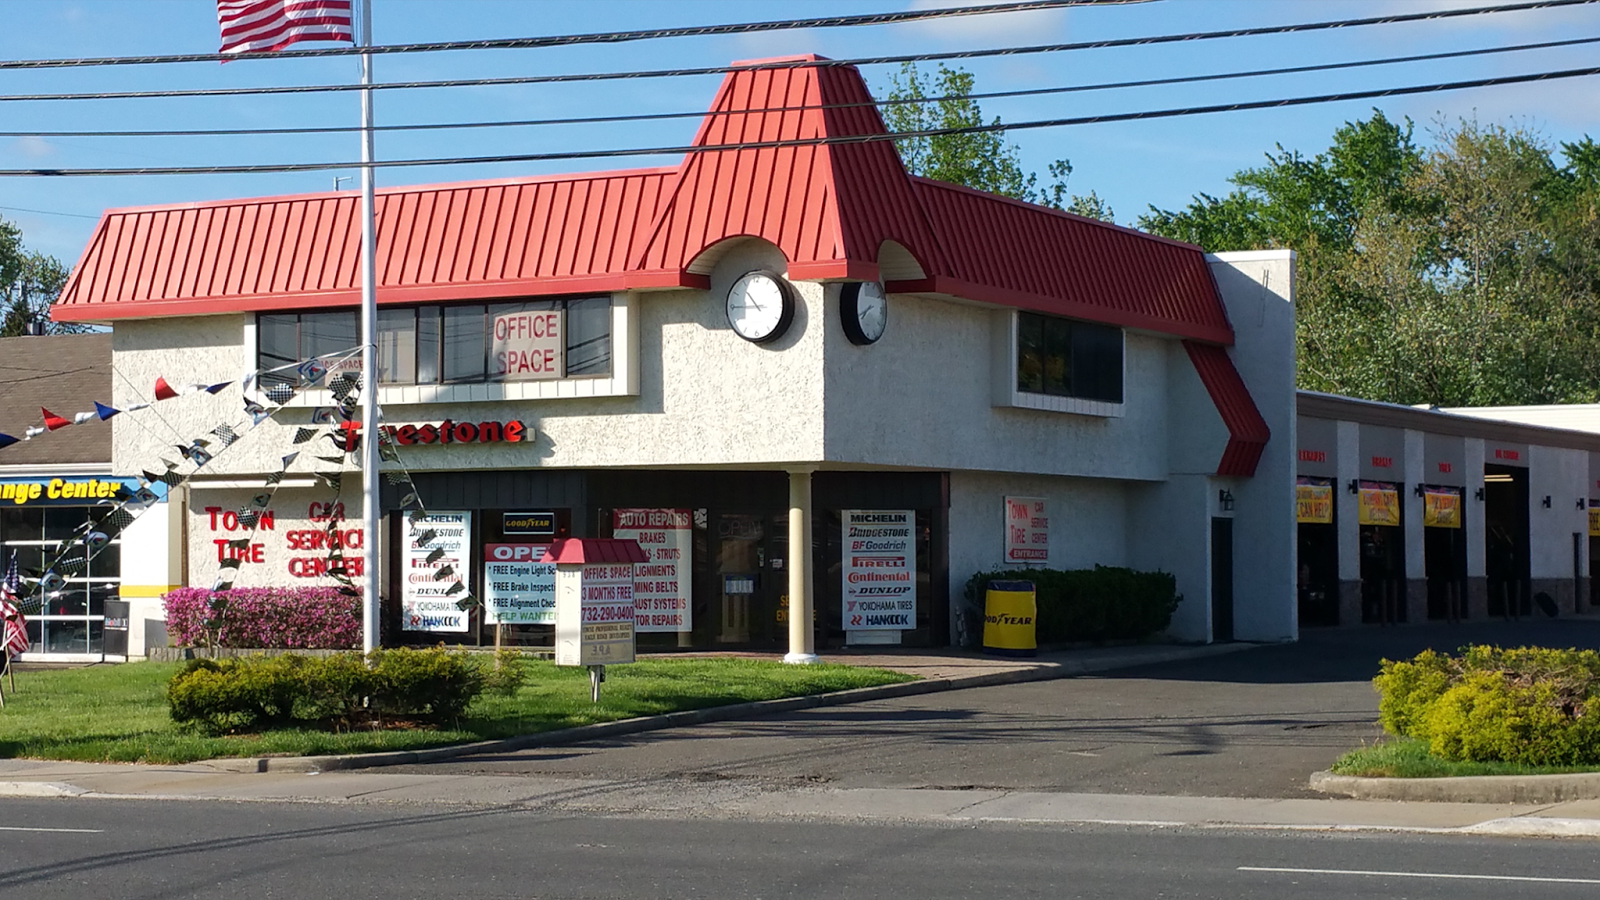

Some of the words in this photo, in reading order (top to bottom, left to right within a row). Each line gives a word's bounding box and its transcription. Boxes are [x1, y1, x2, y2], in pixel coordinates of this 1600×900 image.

[496, 314, 558, 341] OFFICE
[497, 349, 554, 375] SPACE
[340, 419, 524, 452] Festone
[47, 478, 121, 499] Center
[1007, 500, 1028, 519] TOWN
[1035, 502, 1043, 513] CAR
[506, 518, 550, 529] GOODYEAR
[620, 512, 646, 526] AUTO
[648, 512, 689, 526] REPAIRS
[850, 514, 907, 523] MICHELIN
[1031, 517, 1048, 529] SERVICE
[409, 528, 464, 537] BRIESTONE
[639, 532, 666, 543] BRAKES
[848, 527, 909, 538] BRIDGESTONE
[1010, 525, 1026, 544] TIRE
[1032, 533, 1047, 543] CENTER
[493, 546, 551, 560] OPE
[656, 548, 681, 559] STRUTS
[1013, 550, 1047, 558] ENTRANCE
[411, 558, 460, 568] PIREI
[851, 556, 905, 567] PIRELLI
[493, 566, 509, 575] FREE
[510, 566, 530, 577] Engine
[532, 566, 546, 577] Light
[584, 567, 607, 579] OFFICE
[610, 566, 631, 578] SPACE
[847, 571, 910, 584] Continental
[408, 573, 464, 584] Contintal
[493, 582, 509, 591] FREE
[511, 582, 529, 591] Brake
[655, 581, 678, 593] BELTS
[582, 587, 587, 600] 3
[588, 586, 615, 600] MONTHS
[616, 586, 632, 599] FREE
[417, 602, 450, 611] YOKOHAMA
[493, 598, 509, 608] FREE
[510, 598, 540, 610] Alignment
[653, 598, 686, 610] SYSTEMS
[859, 601, 896, 611] YOKOHAMA
[897, 601, 913, 610] TIRES
[492, 612, 517, 620] HELP
[581, 606, 634, 621] 732-290-0400
[985, 613, 1032, 625] ODYEAR
[651, 614, 682, 626] REPAIRS
